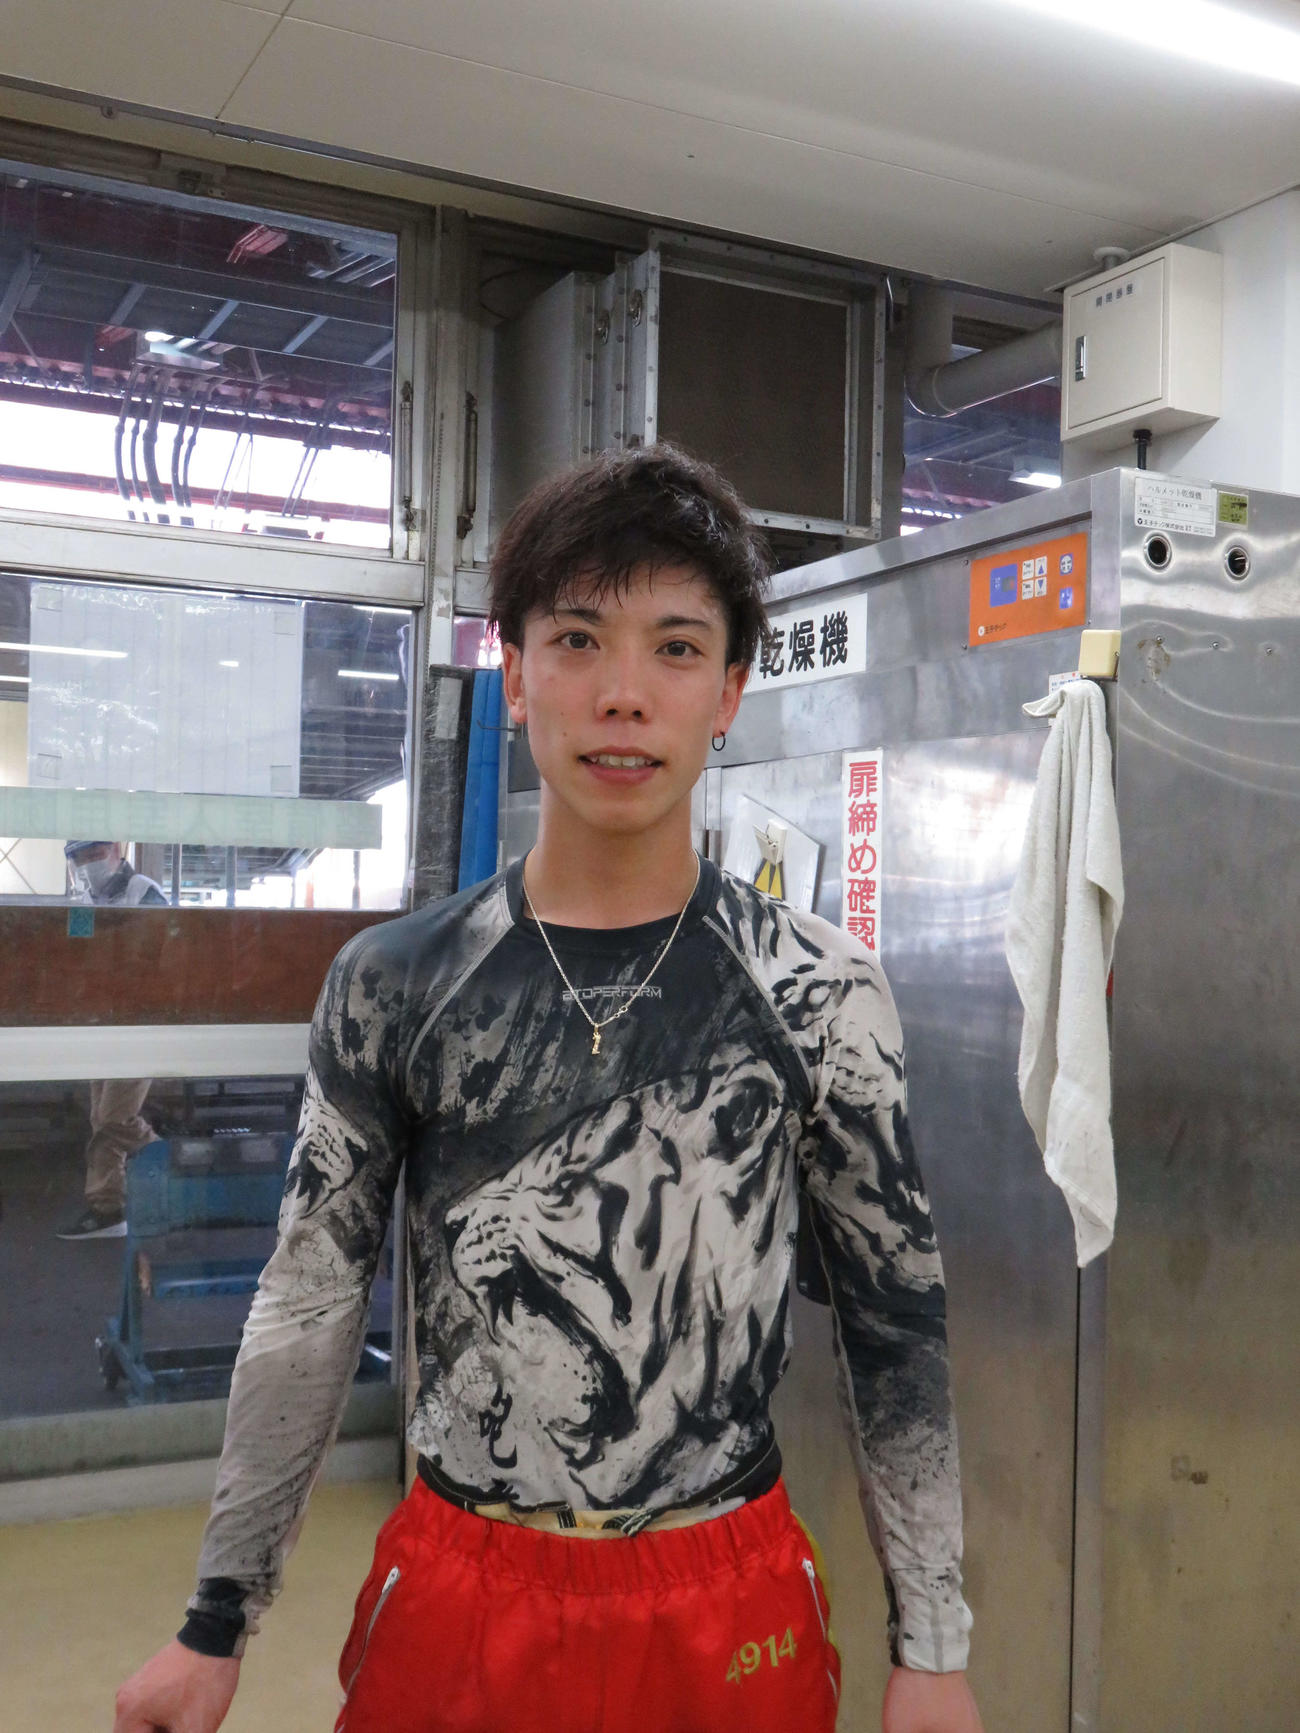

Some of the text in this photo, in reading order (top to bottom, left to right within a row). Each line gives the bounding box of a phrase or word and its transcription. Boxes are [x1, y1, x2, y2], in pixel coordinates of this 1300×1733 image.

[759, 610, 848, 679] 乾燥機
[847, 760, 878, 951] 扉締め確認
[725, 1626, 798, 1684] 4914
